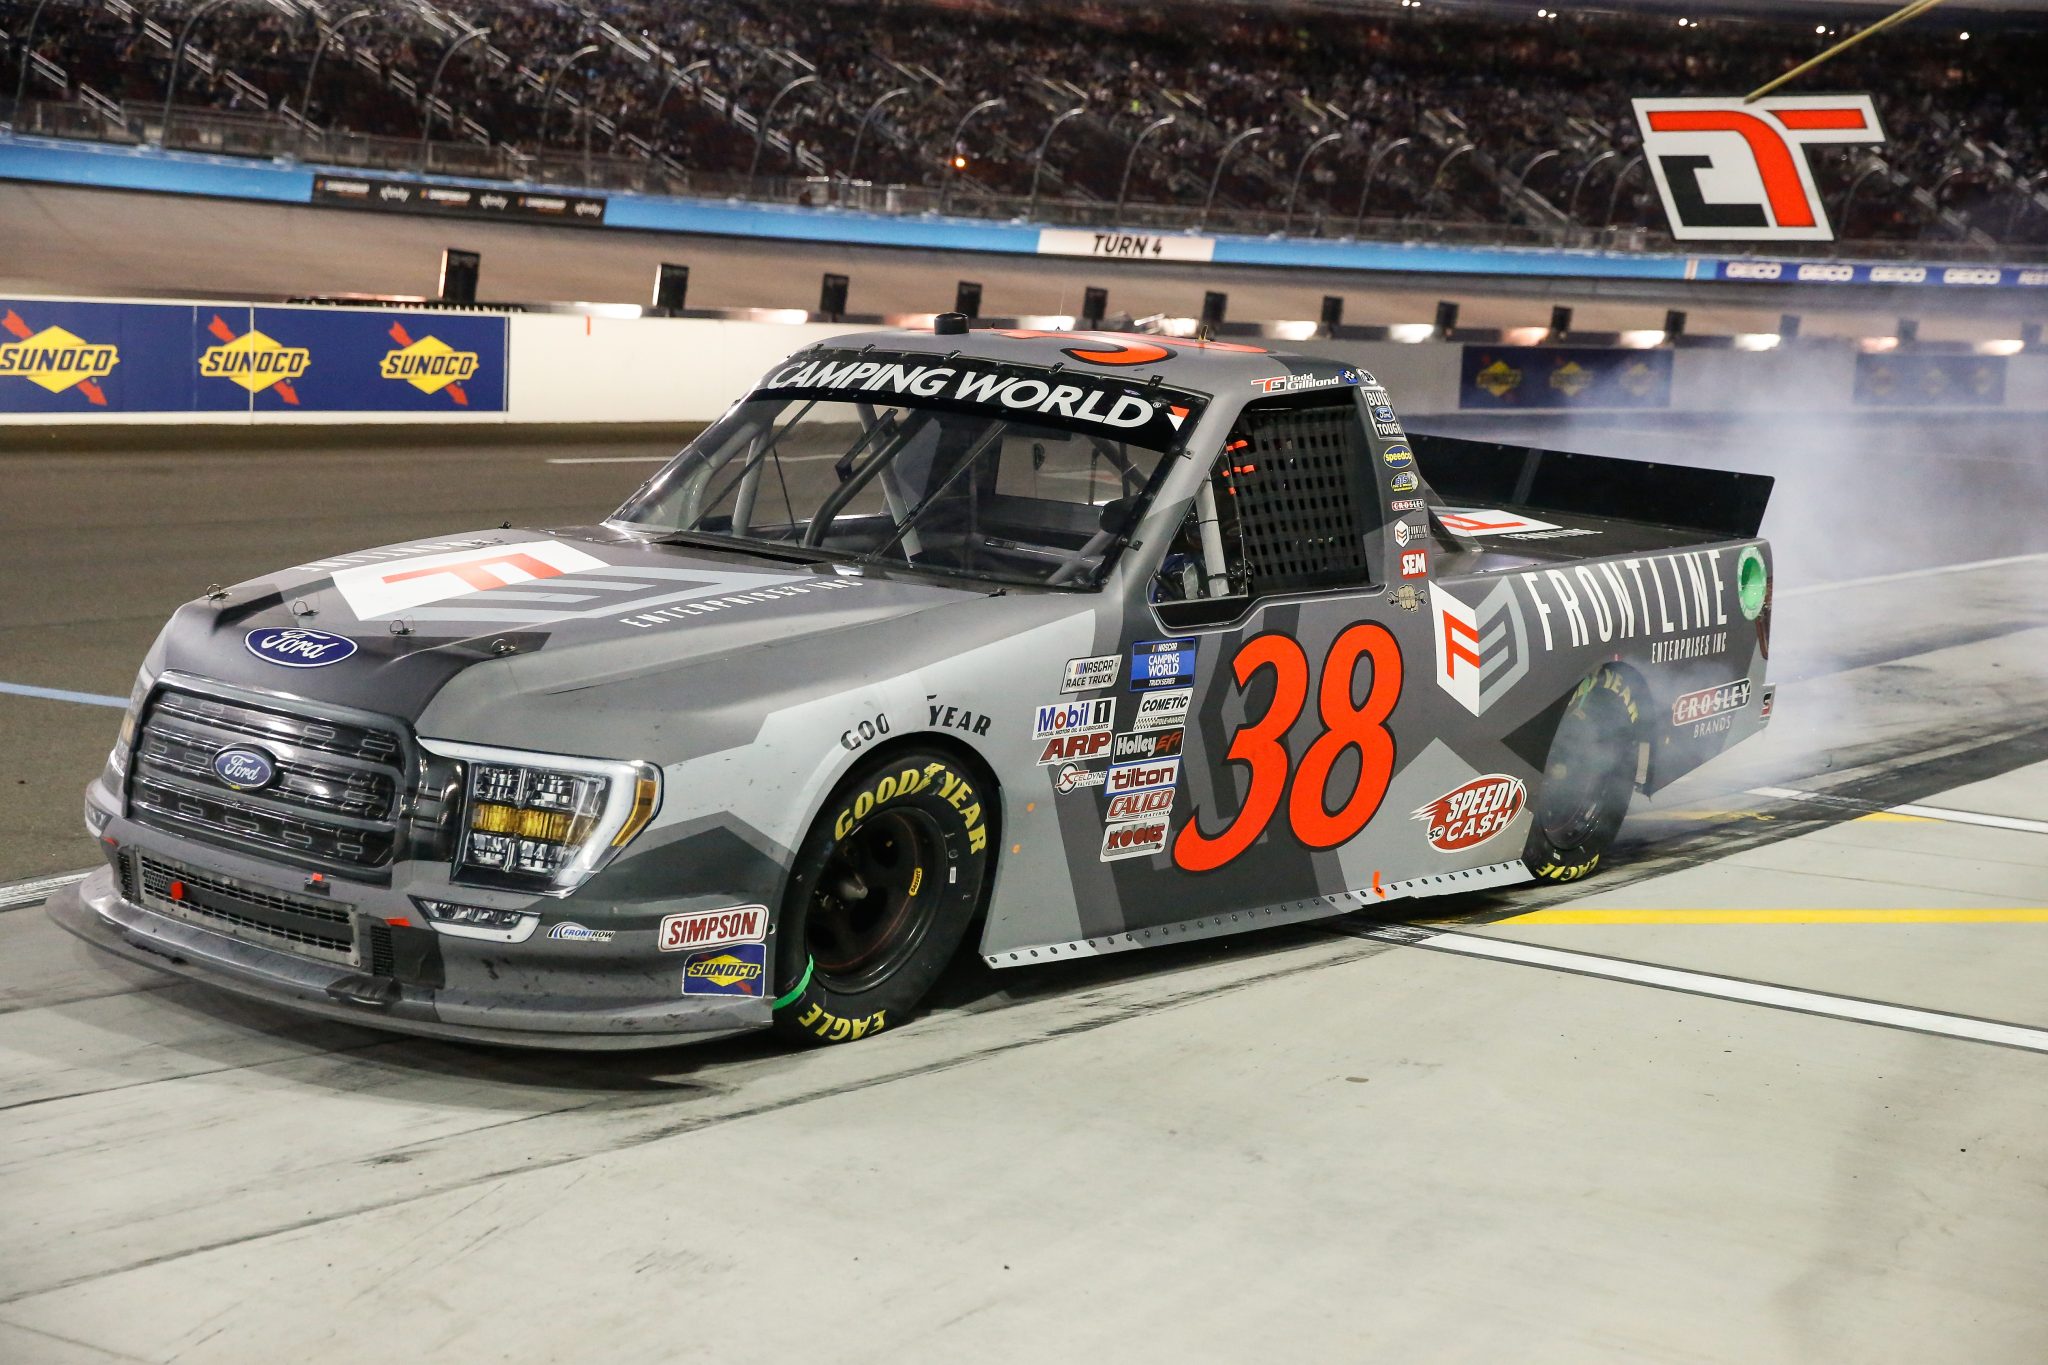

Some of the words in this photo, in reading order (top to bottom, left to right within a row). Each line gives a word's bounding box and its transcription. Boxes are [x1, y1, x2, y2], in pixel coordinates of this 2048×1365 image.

[1094, 234, 1146, 255] TURN
[1152, 238, 1162, 254] 4
[1, 348, 112, 371] SUNOCO
[206, 351, 305, 372] SUNOCO
[386, 355, 474, 375] SUNOCO
[767, 361, 955, 396] CAMPING
[954, 370, 1154, 428] WORLD
[1287, 376, 1339, 390] Gilliland
[1385, 451, 1412, 463] speedco
[1402, 553, 1426, 575] SEM
[620, 585, 809, 628] ENTERPRISES
[1521, 550, 1727, 651] FRONTLINE
[261, 629, 339, 660] Ford
[1651, 635, 1710, 664] ENTERPRISES
[1712, 632, 1727, 654] INC
[1081, 660, 1114, 674] NASCAR
[1149, 653, 1179, 665] CAMPING
[1149, 663, 1179, 677] WORLD
[1066, 679, 1086, 688] RACE
[1087, 674, 1114, 686] TRUCK
[1142, 696, 1189, 712] COMETIC
[1677, 682, 1750, 722] CROSLEY
[1038, 703, 1090, 732] Mobil
[1693, 719, 1732, 738] BRANDS
[1040, 732, 1111, 761] ARP
[1116, 735, 1156, 757] Holley
[1172, 620, 1404, 875] 38
[225, 755, 261, 781] Ford
[1112, 767, 1174, 790] tilton
[1109, 790, 1174, 817] CALICO
[1446, 778, 1523, 822] SPEEDY
[1108, 824, 1165, 849] KOOKS
[1429, 828, 1442, 838] SC
[1446, 810, 1512, 841] CA$H
[668, 912, 758, 945] SIMPSON
[690, 963, 758, 979] SUNOCO
[799, 1003, 888, 1041] EAGLE
